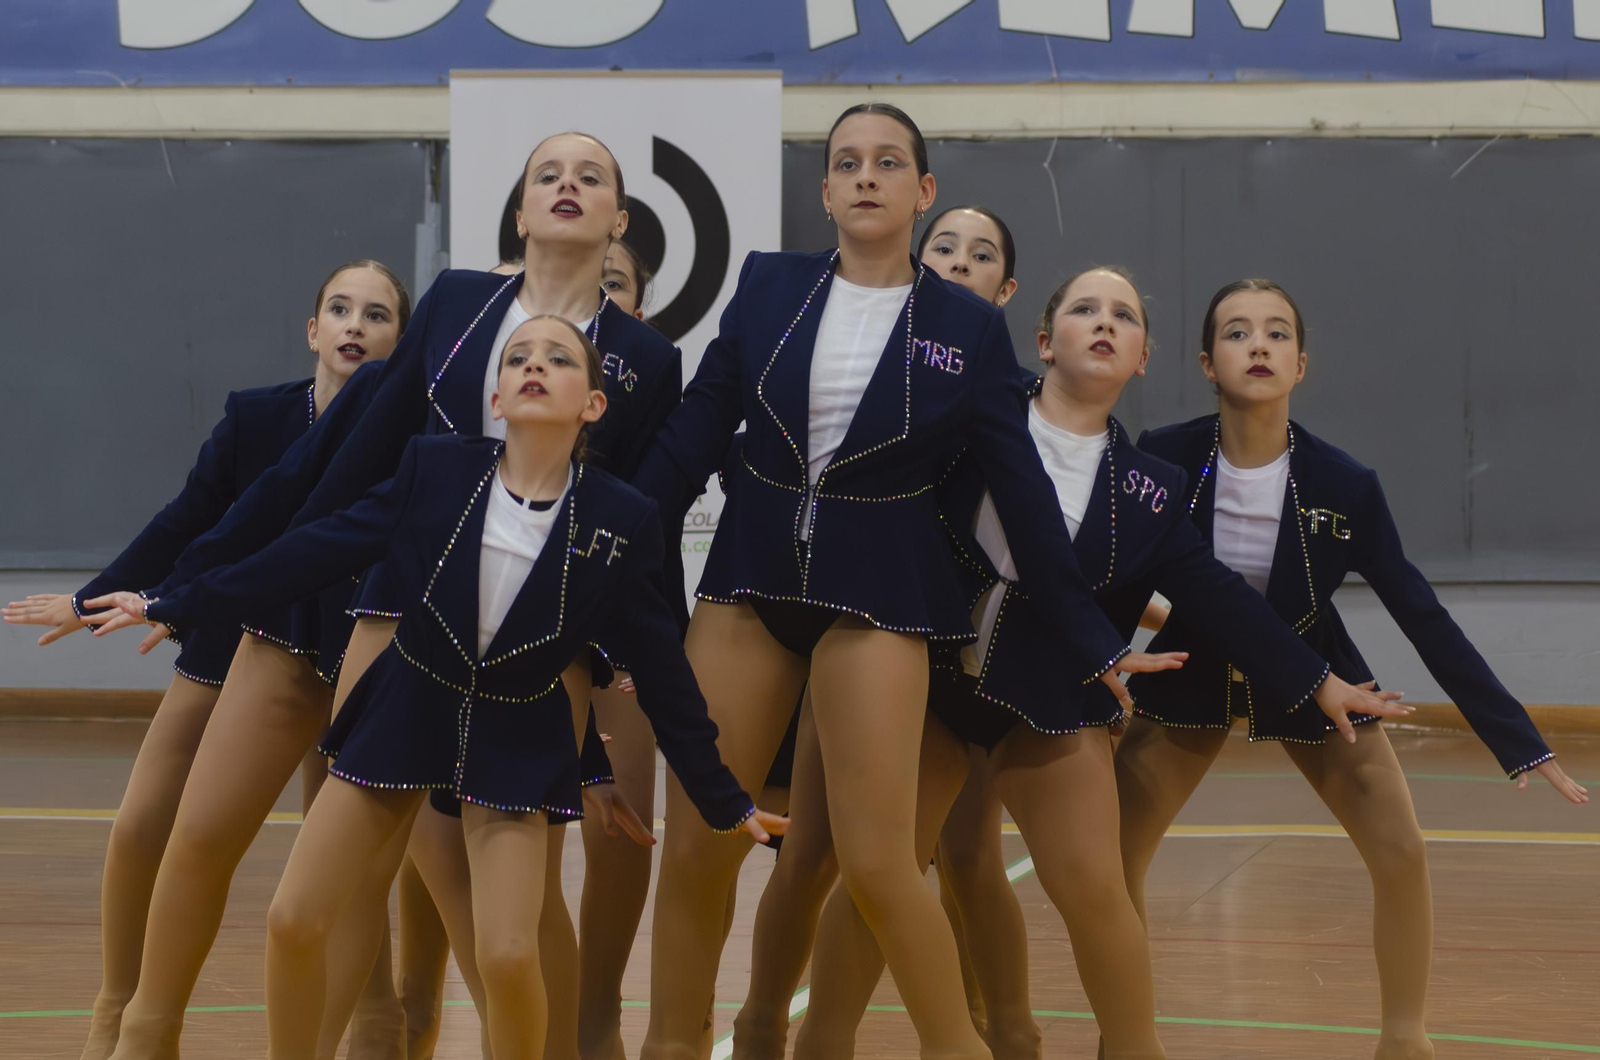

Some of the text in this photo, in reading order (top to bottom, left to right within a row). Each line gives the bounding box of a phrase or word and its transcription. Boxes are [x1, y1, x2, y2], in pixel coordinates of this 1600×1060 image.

[601, 352, 638, 392] EVS
[911, 337, 964, 375] MRG
[1122, 469, 1168, 513] SPC
[683, 512, 721, 528] COL
